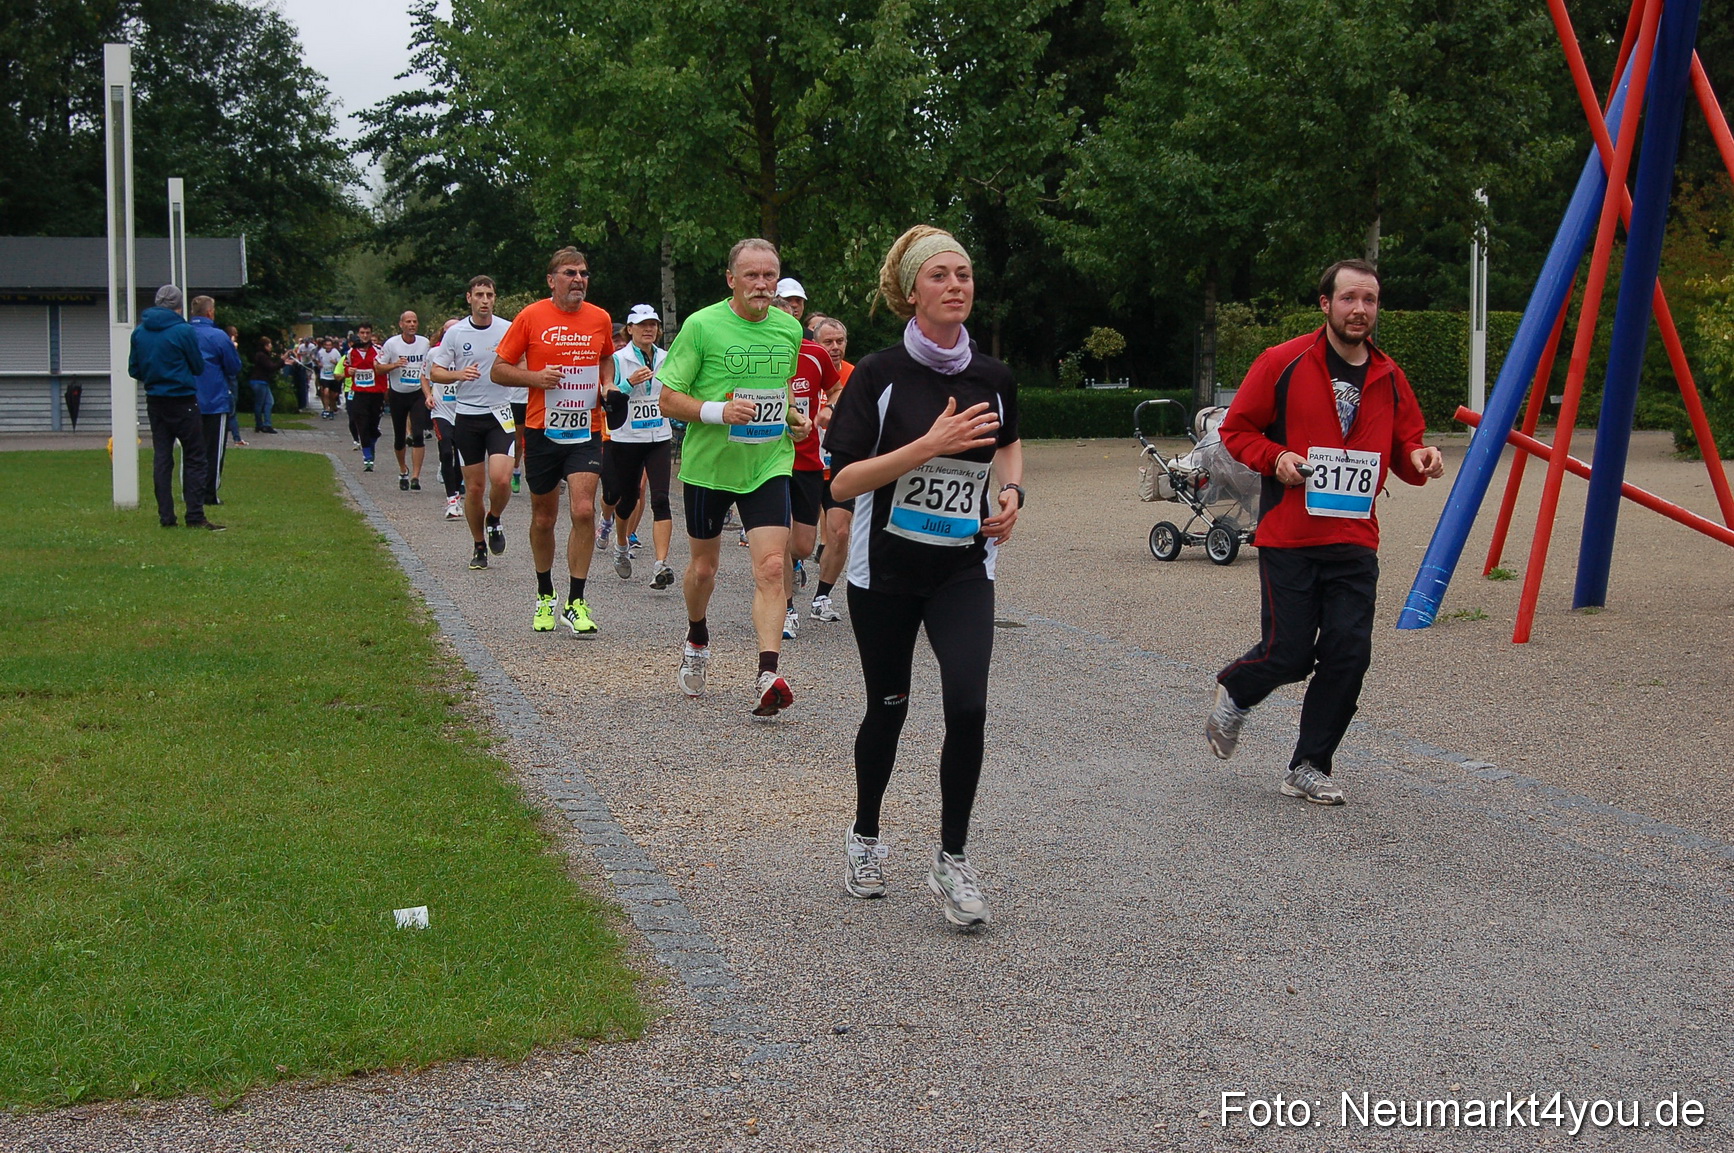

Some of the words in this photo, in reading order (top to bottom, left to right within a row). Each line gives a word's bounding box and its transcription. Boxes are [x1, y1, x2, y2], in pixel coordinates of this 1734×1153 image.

[550, 331, 593, 342] Fischer
[725, 345, 790, 374] OPF
[401, 369, 420, 379] 2427
[556, 382, 595, 390] Stimme
[734, 392, 755, 400] PARTL
[633, 403, 662, 419] 206
[751, 402, 783, 423] 022
[549, 411, 588, 428] 2786
[746, 427, 773, 436] Werner
[1309, 453, 1333, 462] PARTL
[936, 466, 974, 478] Neumarkt
[1313, 464, 1373, 494] 3178
[903, 476, 975, 514] 2523
[921, 518, 952, 535] Julia
